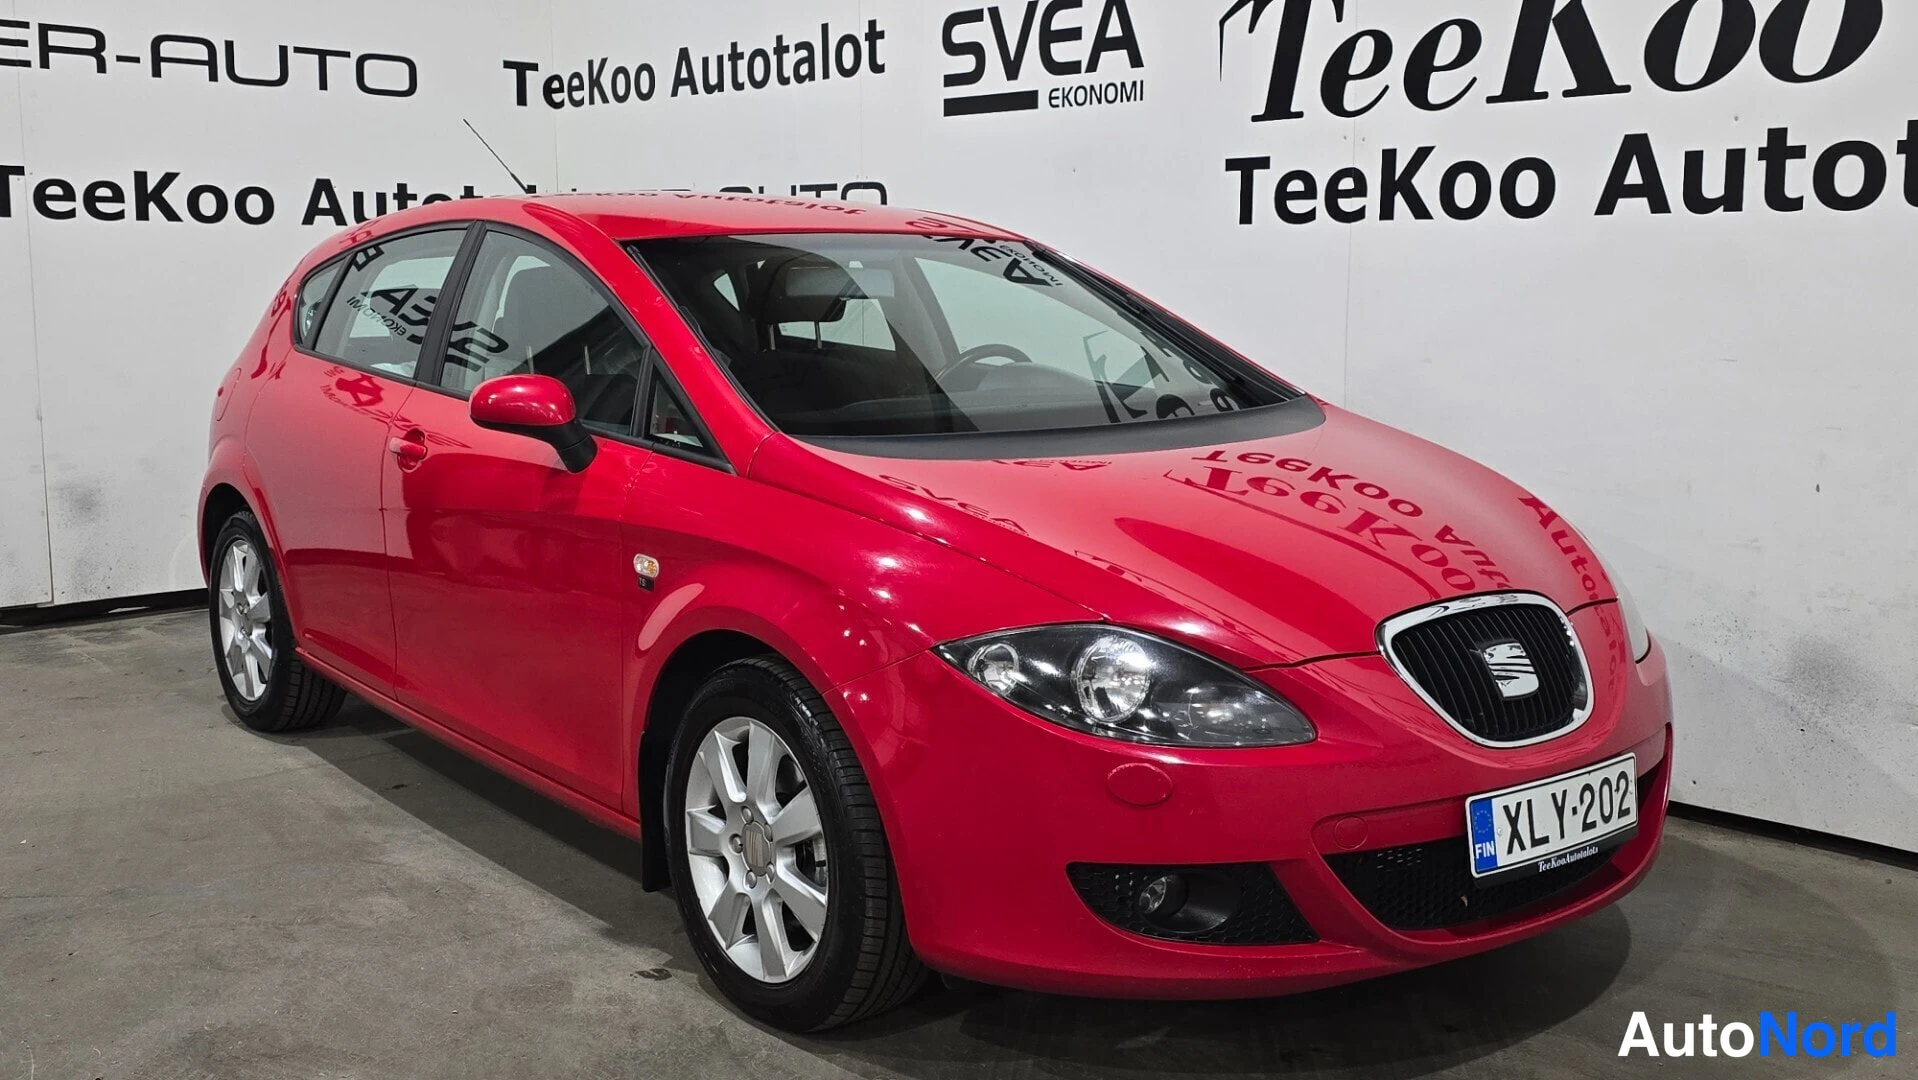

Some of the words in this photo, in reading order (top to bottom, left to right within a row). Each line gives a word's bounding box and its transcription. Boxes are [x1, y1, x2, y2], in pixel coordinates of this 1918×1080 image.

[503, 57, 656, 110] TeeKoo
[671, 19, 886, 98] Autotalot
[942, 0, 1145, 88] SVEA
[1048, 79, 1144, 109] EKONOMI
[1225, 145, 1557, 226] TeeKoo
[1475, 840, 1495, 860] FIN
